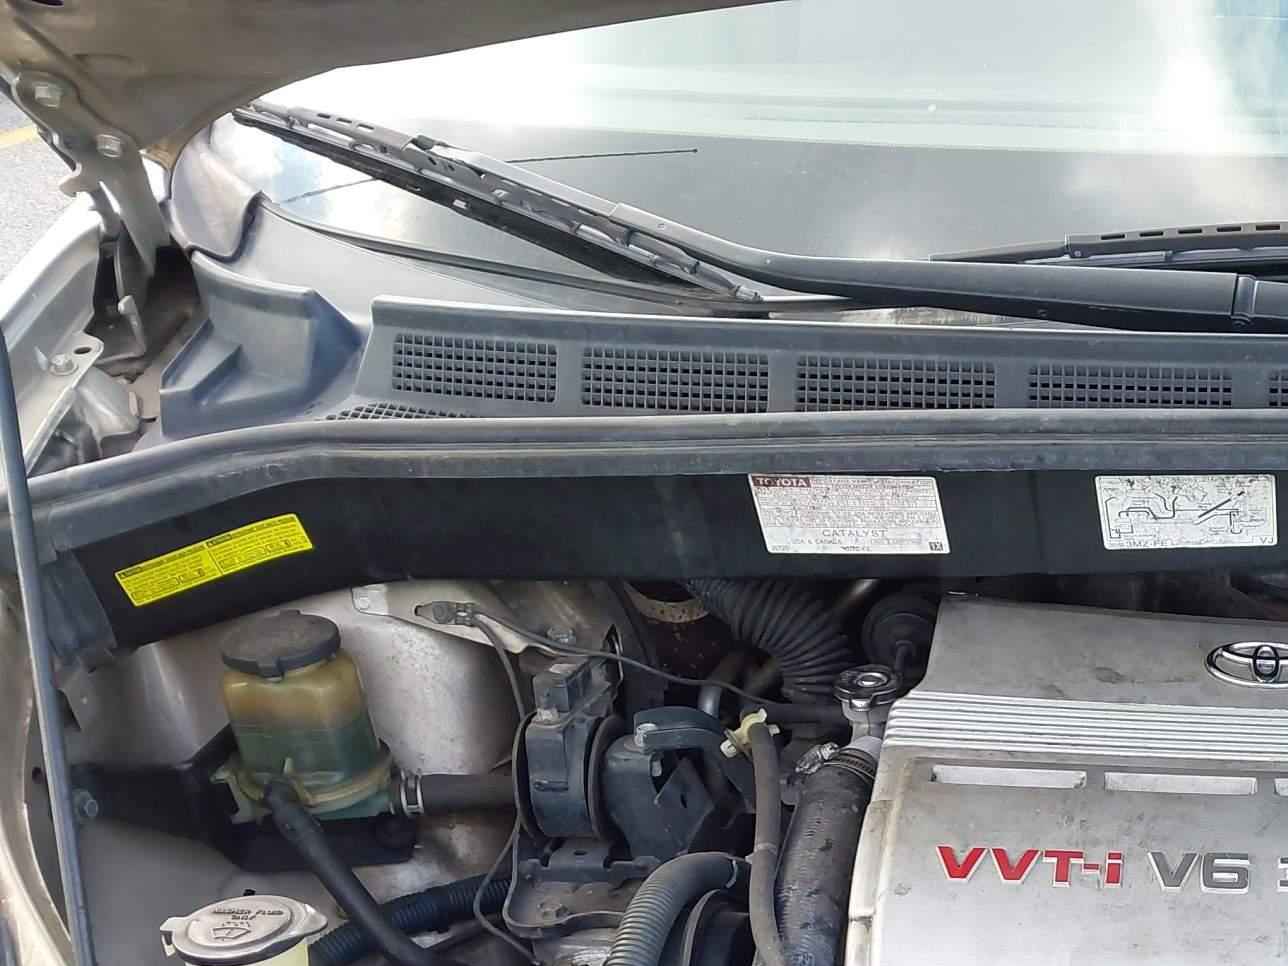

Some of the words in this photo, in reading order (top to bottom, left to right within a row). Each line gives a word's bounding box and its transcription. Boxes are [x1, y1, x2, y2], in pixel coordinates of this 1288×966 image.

[756, 477, 807, 487] TOYOTA
[822, 529, 887, 537] CATALYST
[936, 845, 1124, 888] VVT-i
[1148, 850, 1251, 894] V6
